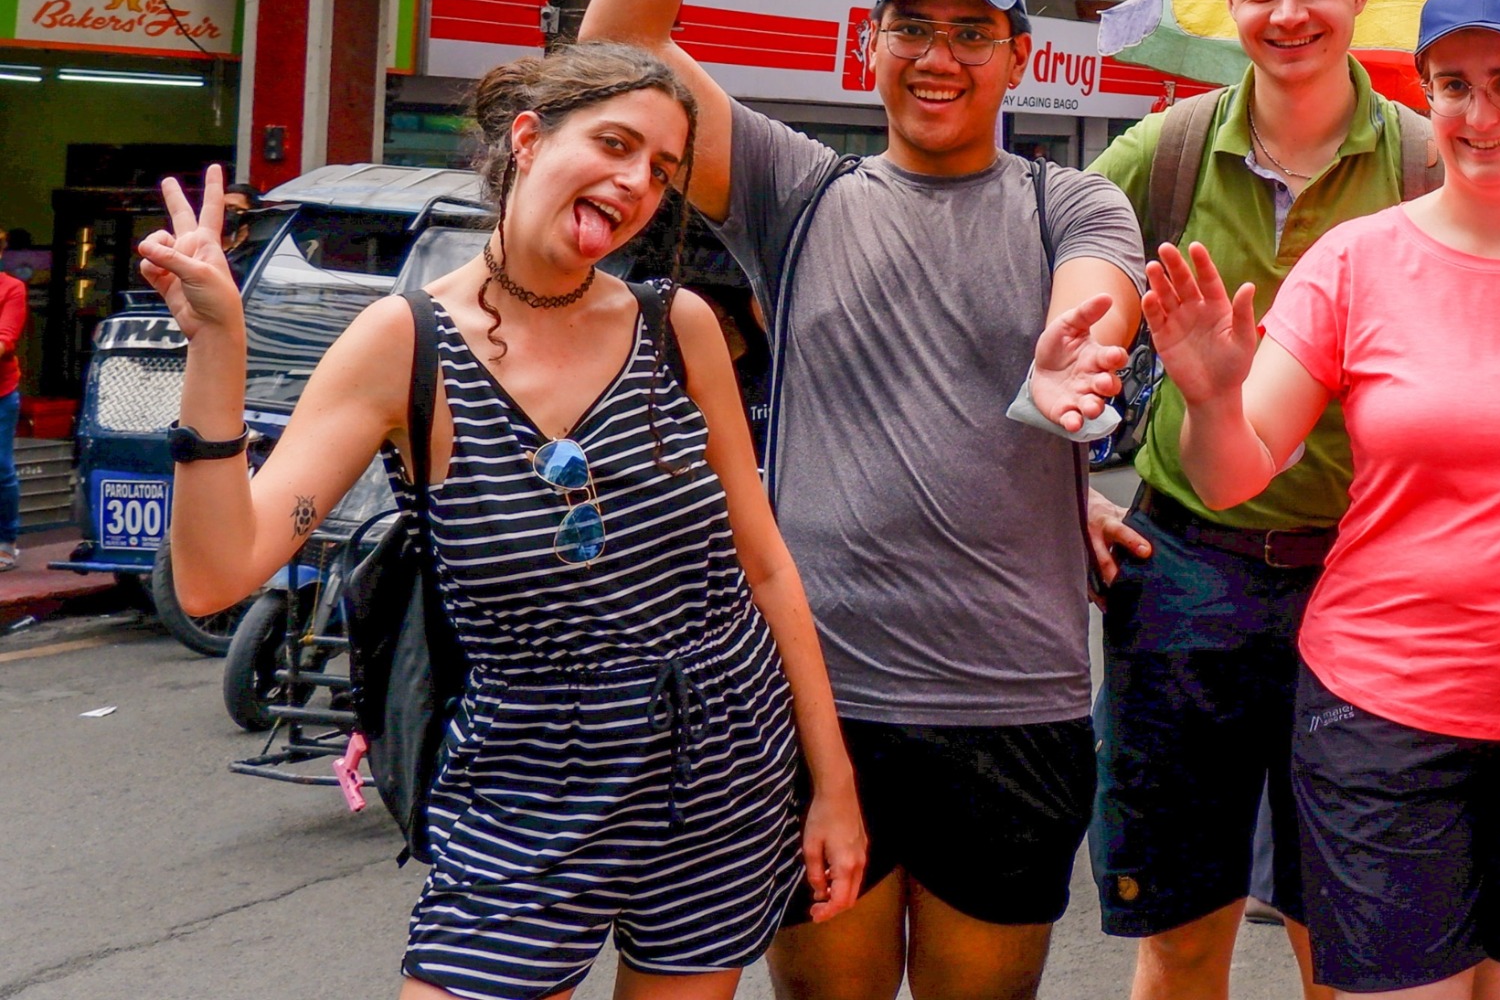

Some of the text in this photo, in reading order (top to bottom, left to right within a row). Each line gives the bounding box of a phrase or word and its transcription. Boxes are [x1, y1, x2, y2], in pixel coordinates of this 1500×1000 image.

[144, 7, 221, 39] Fair
[1033, 41, 1096, 97] drug
[1017, 96, 1051, 108] LAGING
[1053, 98, 1079, 110] BAGO
[105, 483, 164, 499] PAROLATODA
[106, 499, 161, 536] 300
